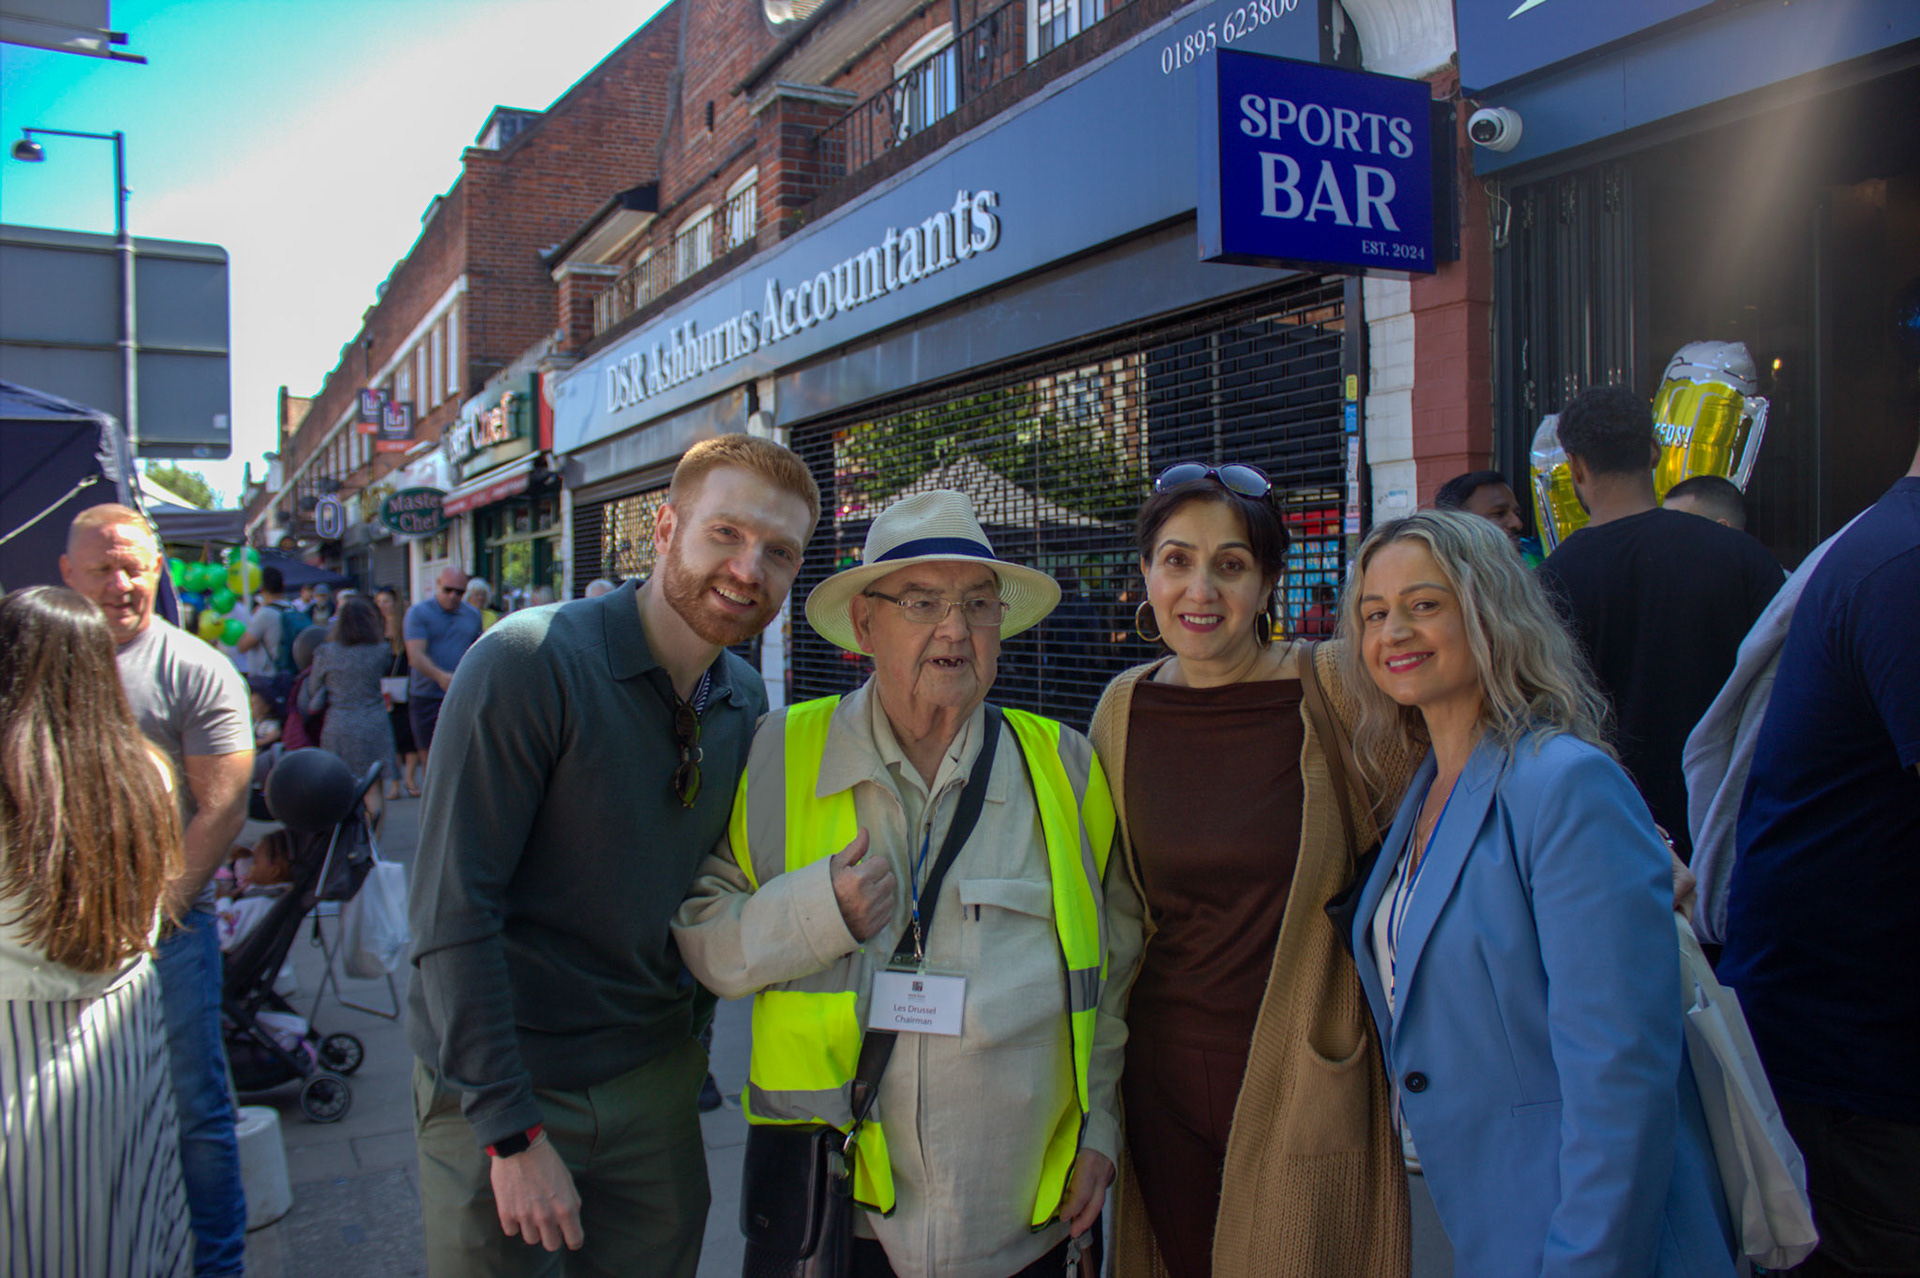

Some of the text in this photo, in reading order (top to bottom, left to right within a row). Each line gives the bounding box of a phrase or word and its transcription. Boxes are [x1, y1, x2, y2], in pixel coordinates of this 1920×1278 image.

[1161, 22, 1217, 75] 01895
[1239, 93, 1414, 159] SPORTS
[1258, 151, 1401, 232] BAR
[1361, 239, 1426, 261] EST. 2024
[606, 189, 999, 413] DSR Ashburns Accountants
[470, 390, 516, 449] Chef
[388, 491, 441, 514] Maste
[399, 509, 440, 533] Chef
[893, 1004, 937, 1015] Les Drussel
[894, 1014, 933, 1026] Chairman
